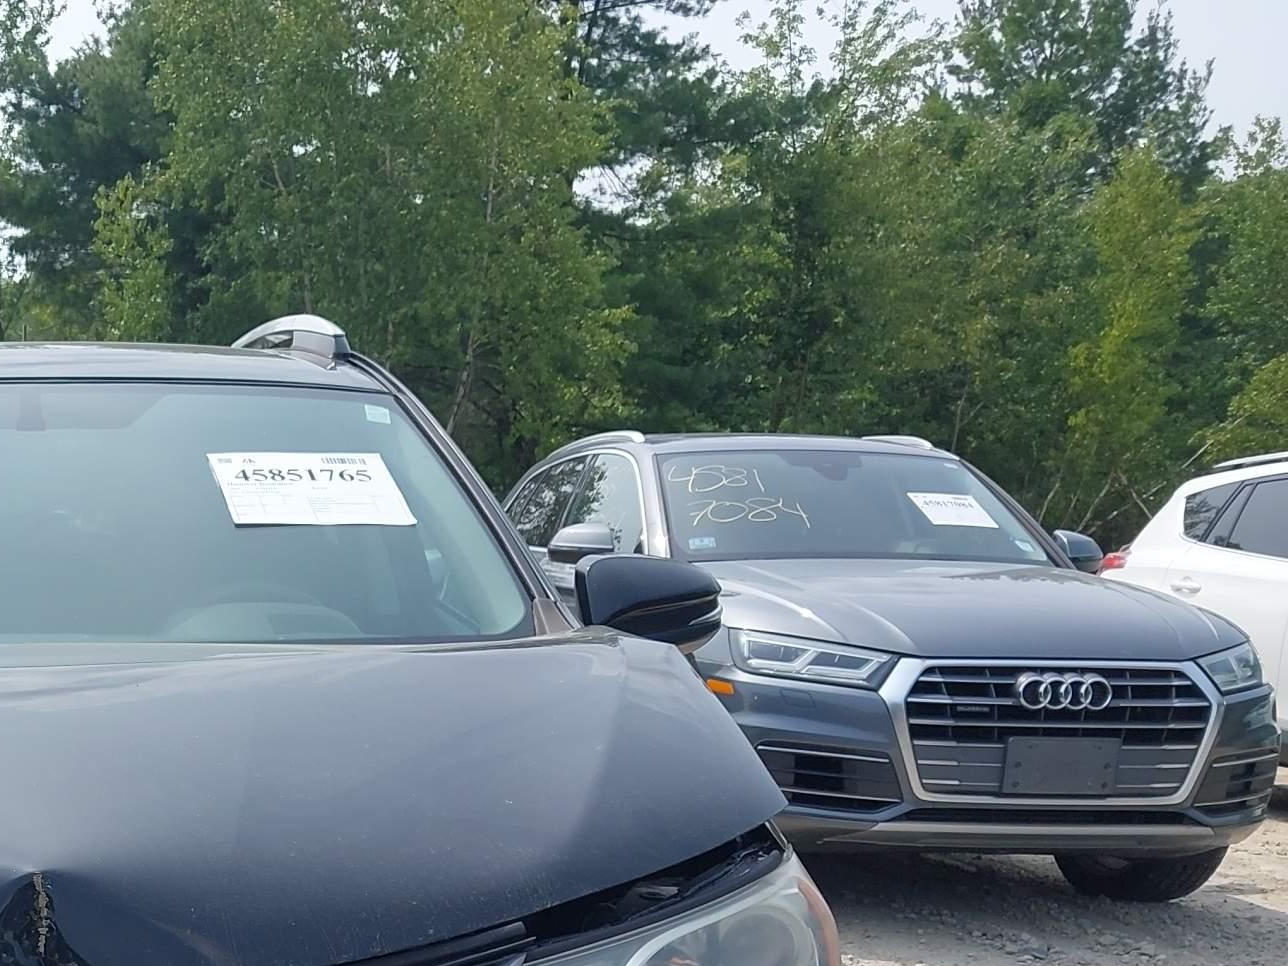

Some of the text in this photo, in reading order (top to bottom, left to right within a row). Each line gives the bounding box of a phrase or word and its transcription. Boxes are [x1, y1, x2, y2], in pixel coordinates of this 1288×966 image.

[234, 468, 372, 482] 45851765
[667, 464, 765, 493] 4581
[688, 498, 811, 529] 7084
